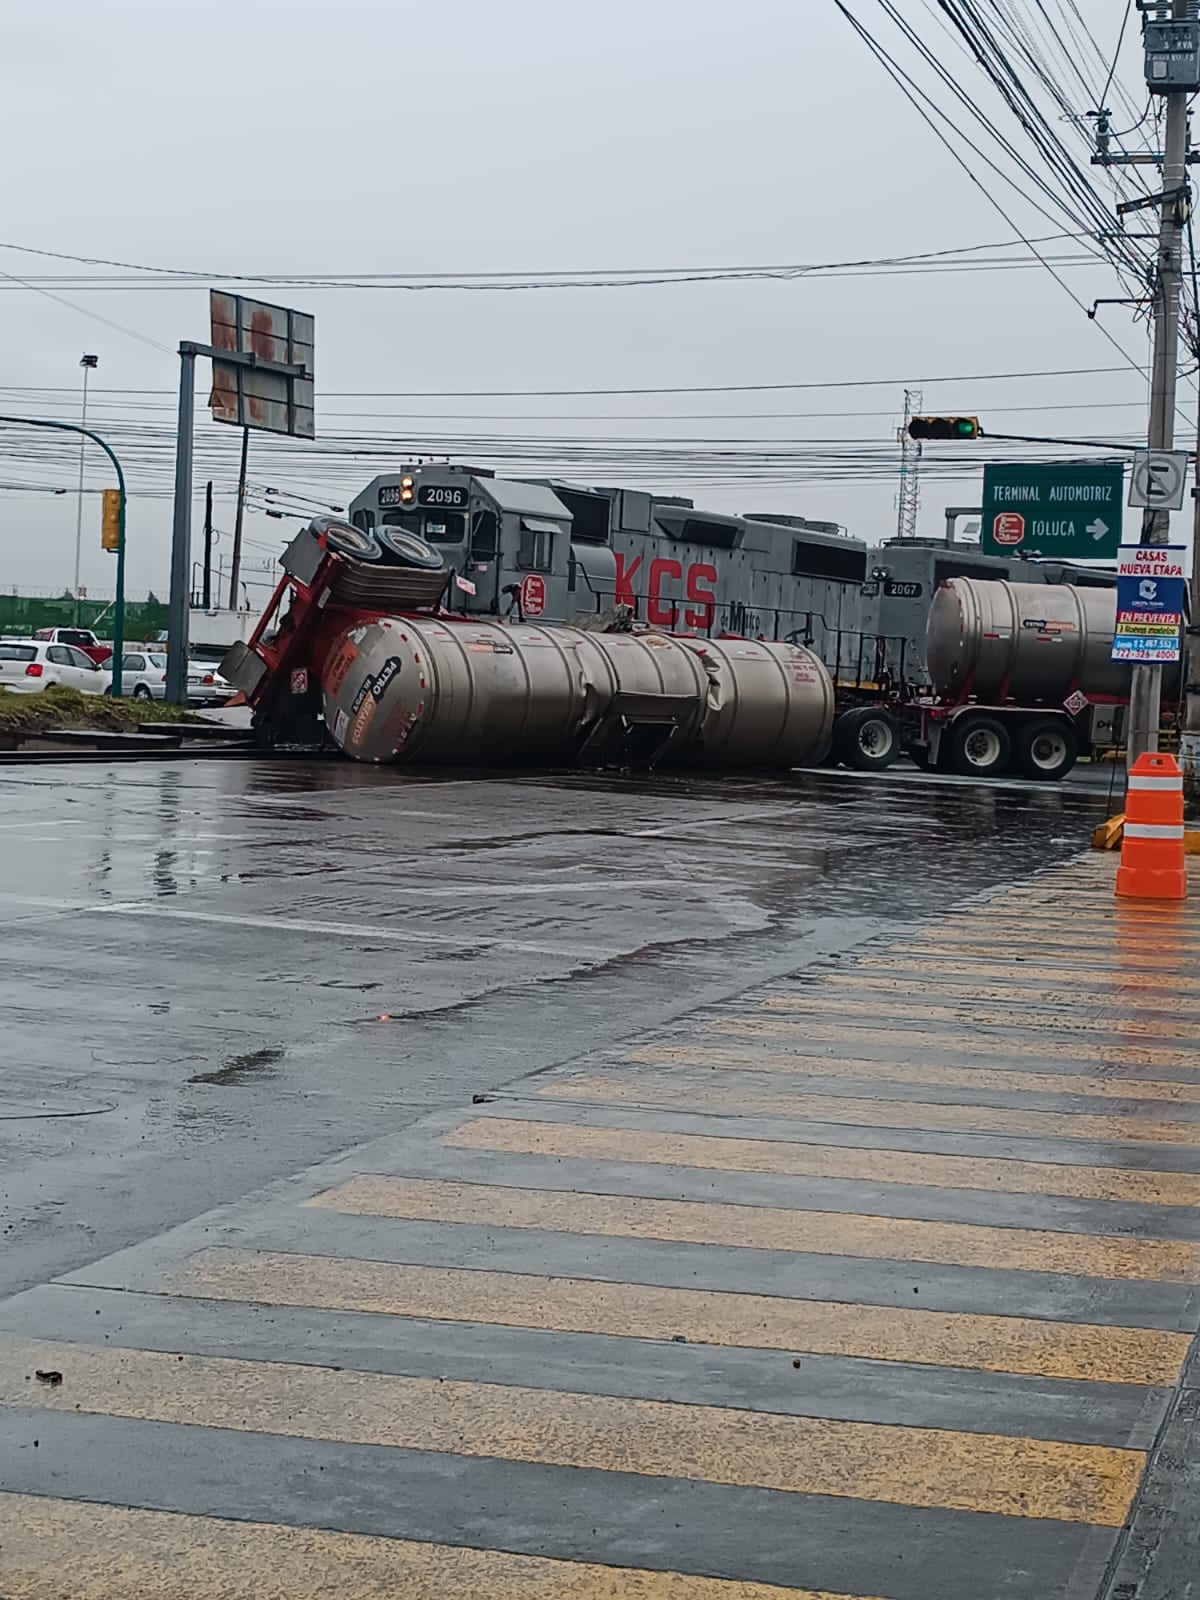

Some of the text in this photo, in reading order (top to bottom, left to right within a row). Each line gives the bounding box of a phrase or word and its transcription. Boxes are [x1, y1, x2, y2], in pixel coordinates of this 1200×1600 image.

[426, 489, 461, 504] 2096
[993, 485, 1112, 501] TERMINAL AUTOMOTRIZ
[1032, 520, 1075, 537] TOLUCA
[1135, 550, 1167, 561] CASAS
[1120, 563, 1182, 576] NUEVA ETAPA
[614, 552, 718, 629] KCS
[1120, 611, 1176, 624] EN PREVENTA
[372, 660, 397, 696] PETRO
